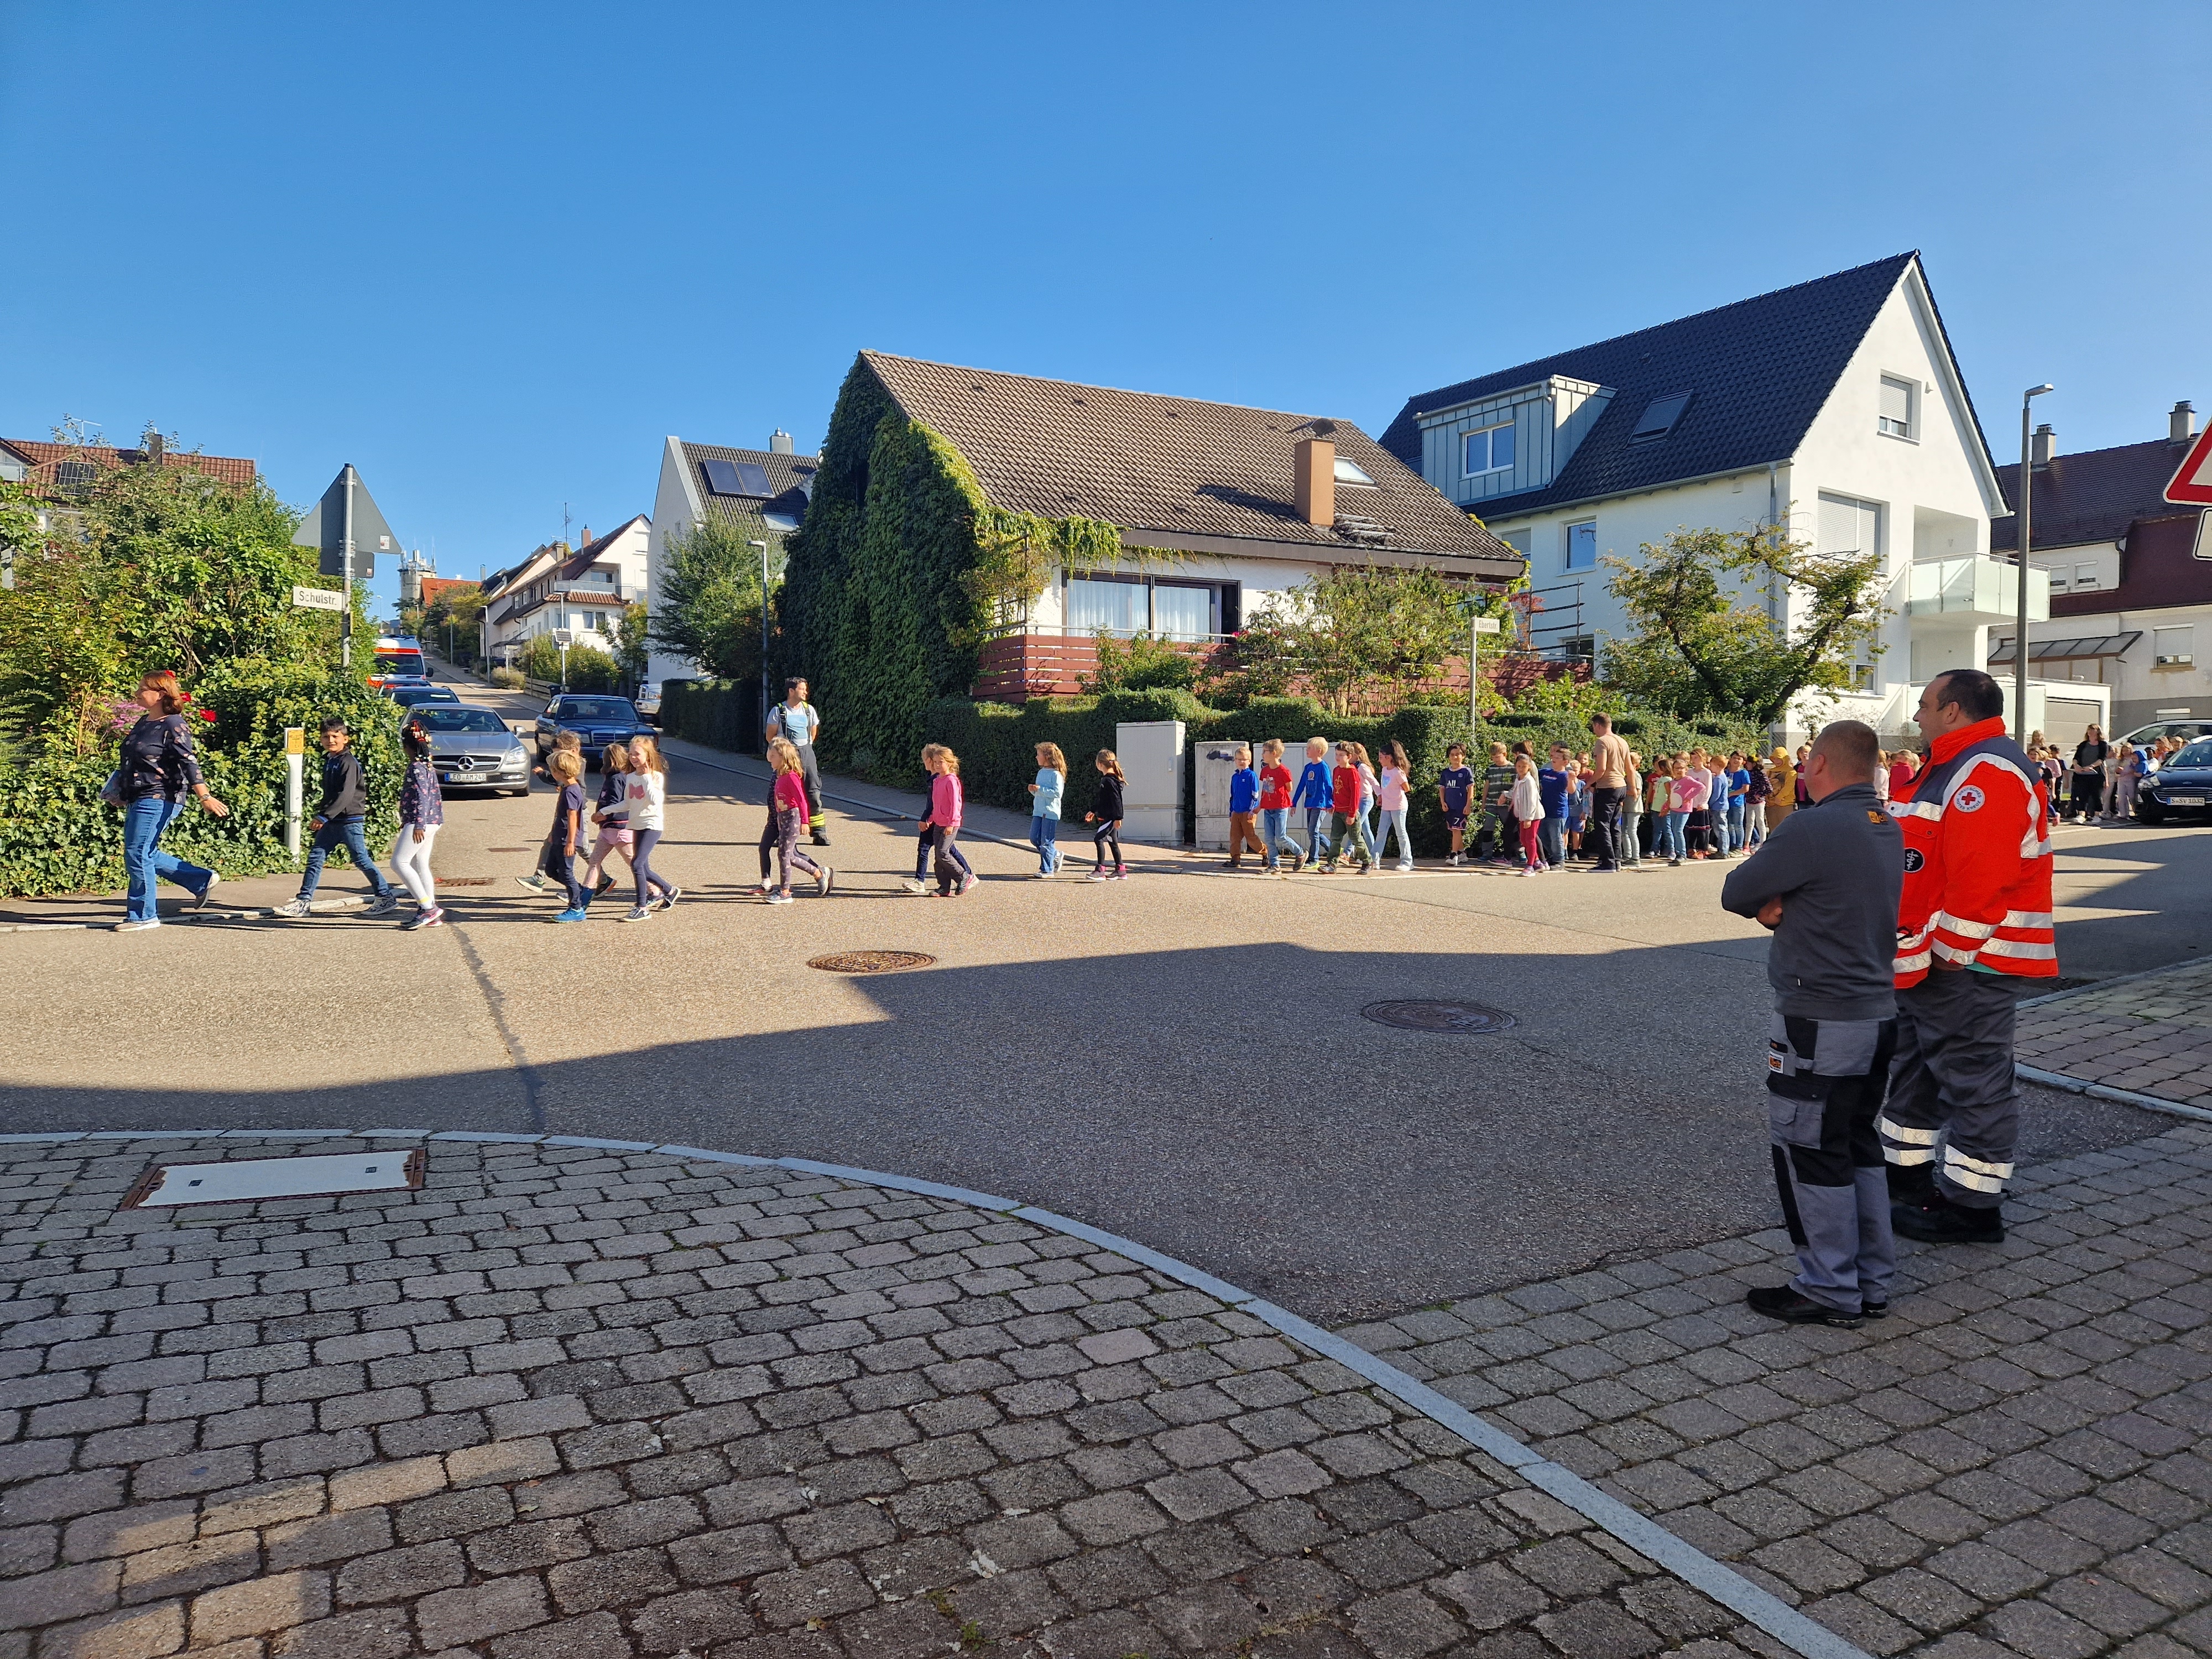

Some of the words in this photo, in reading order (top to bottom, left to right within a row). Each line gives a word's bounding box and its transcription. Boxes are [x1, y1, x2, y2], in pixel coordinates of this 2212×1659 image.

[299, 591, 337, 606] Schulstr.
[1479, 620, 1498, 629] Ebertstr.
[1958, 787, 1982, 797] DEUTSCHES
